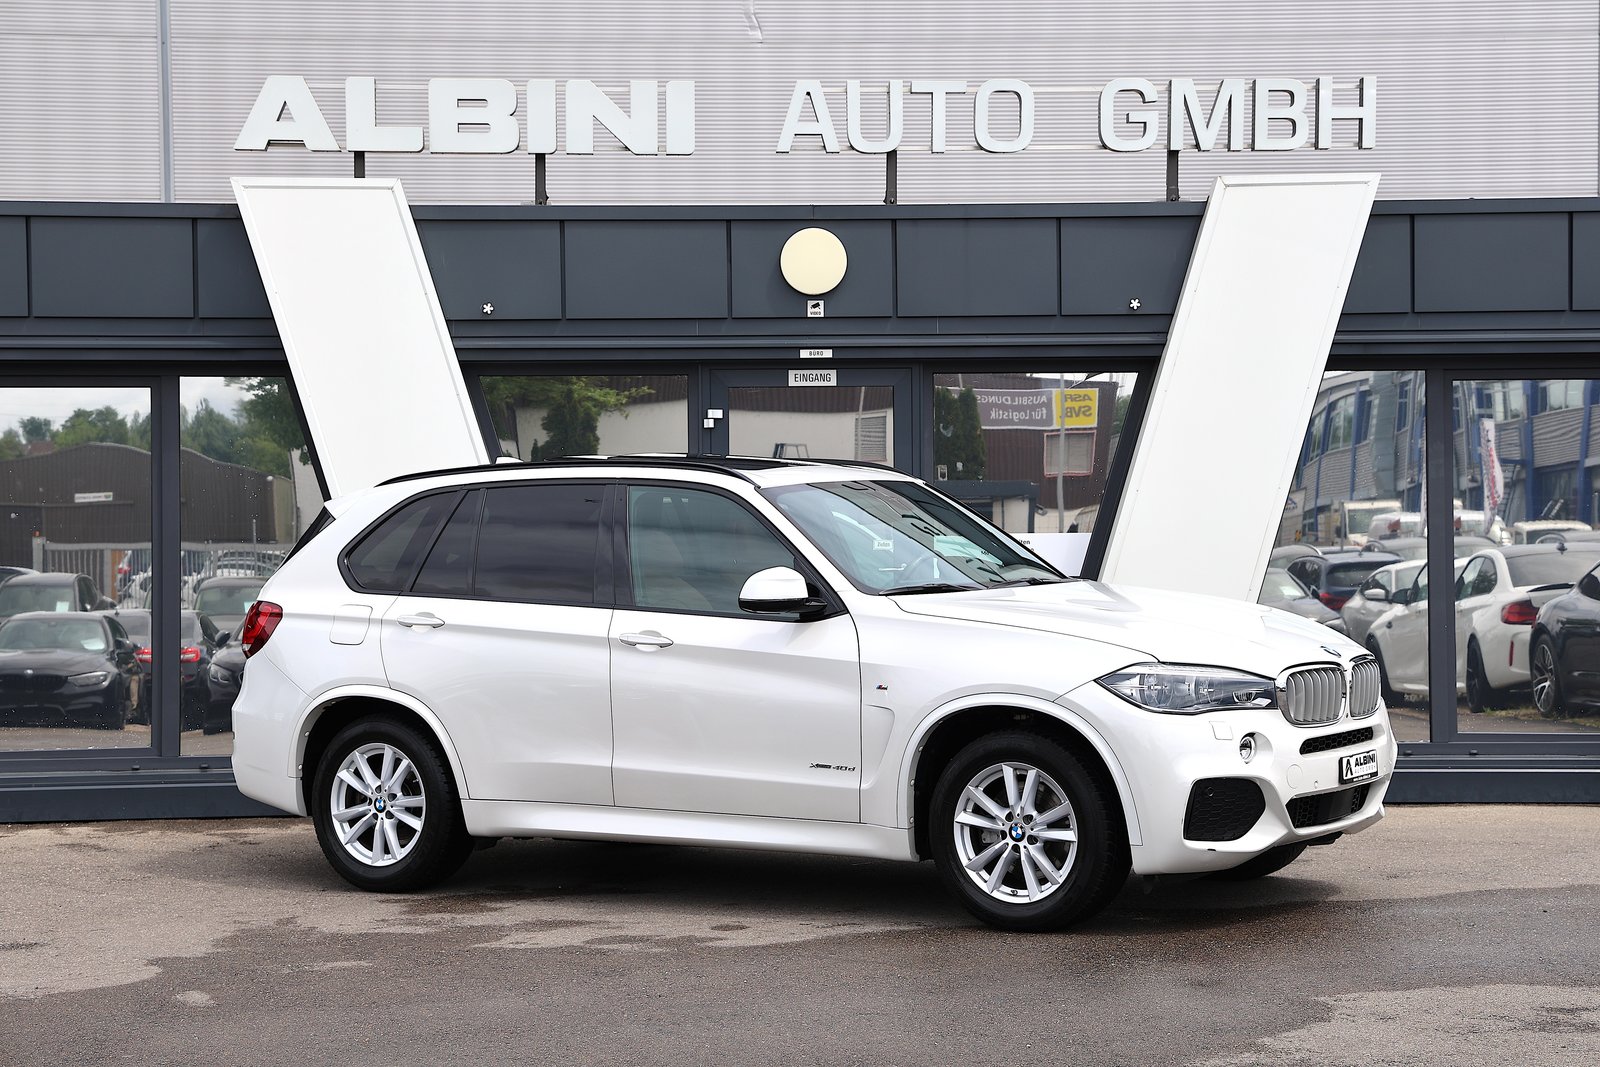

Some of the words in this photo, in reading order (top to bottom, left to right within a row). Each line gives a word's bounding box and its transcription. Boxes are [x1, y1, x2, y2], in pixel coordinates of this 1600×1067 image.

[233, 74, 696, 156] ALBINI
[776, 78, 1036, 154] AUTO
[1098, 75, 1378, 153] GMBH
[794, 373, 831, 382] EINGANG
[1354, 753, 1376, 768] ALBINI
